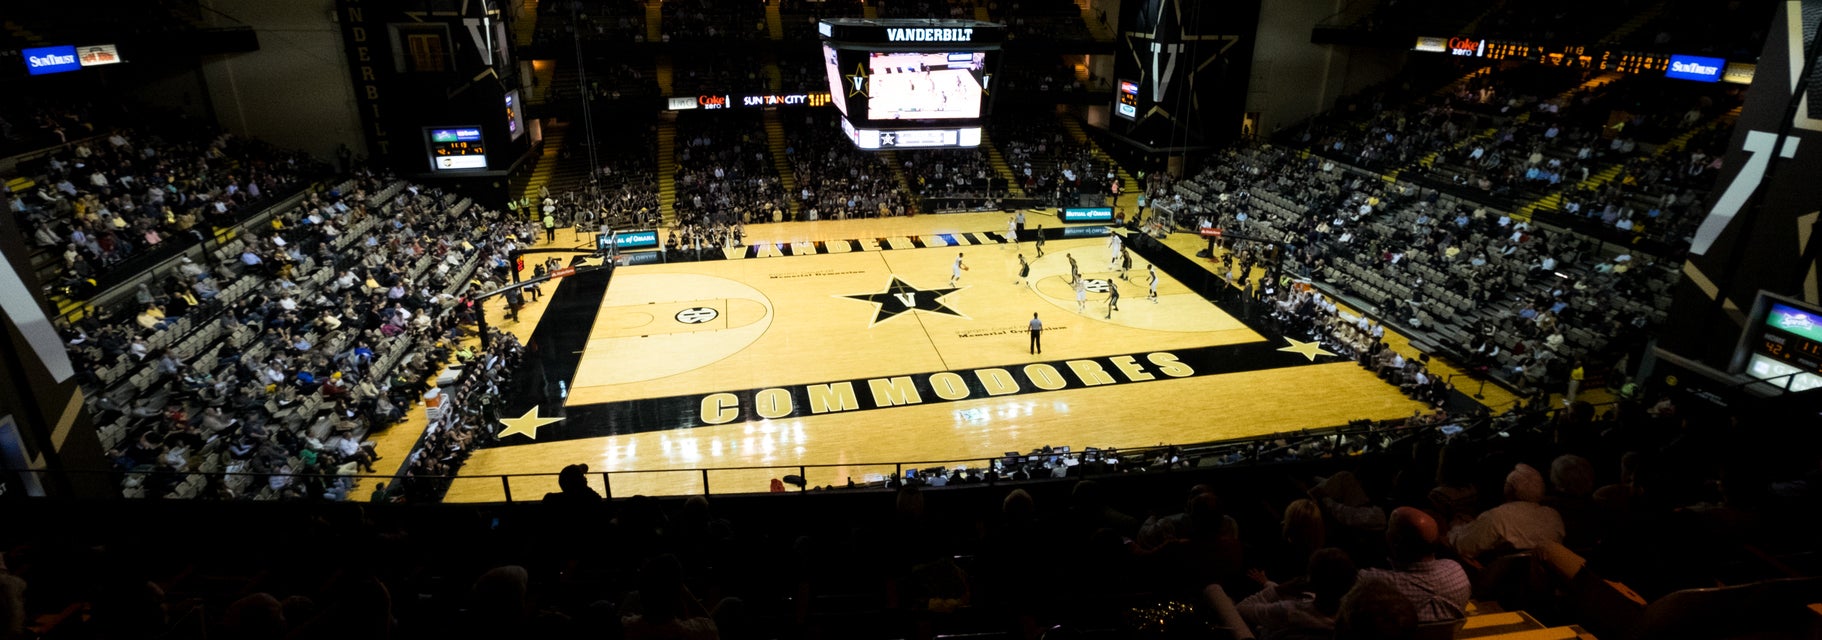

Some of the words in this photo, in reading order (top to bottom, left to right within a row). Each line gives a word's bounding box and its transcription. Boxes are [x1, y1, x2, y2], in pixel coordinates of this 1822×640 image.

[887, 28, 973, 41] VANDERBILT
[1449, 36, 1479, 51] Coke
[1452, 48, 1472, 56] zero
[347, 0, 389, 154] NDERBILT
[853, 76, 863, 91] V
[699, 94, 725, 105] Coke
[743, 95, 763, 106] SUN
[764, 95, 785, 105] TAN
[785, 94, 807, 104] CITY
[633, 234, 655, 242] OMAHA
[893, 292, 916, 307] V
[958, 330, 1007, 339] Memorial
[700, 352, 1195, 424] COMMODORES
